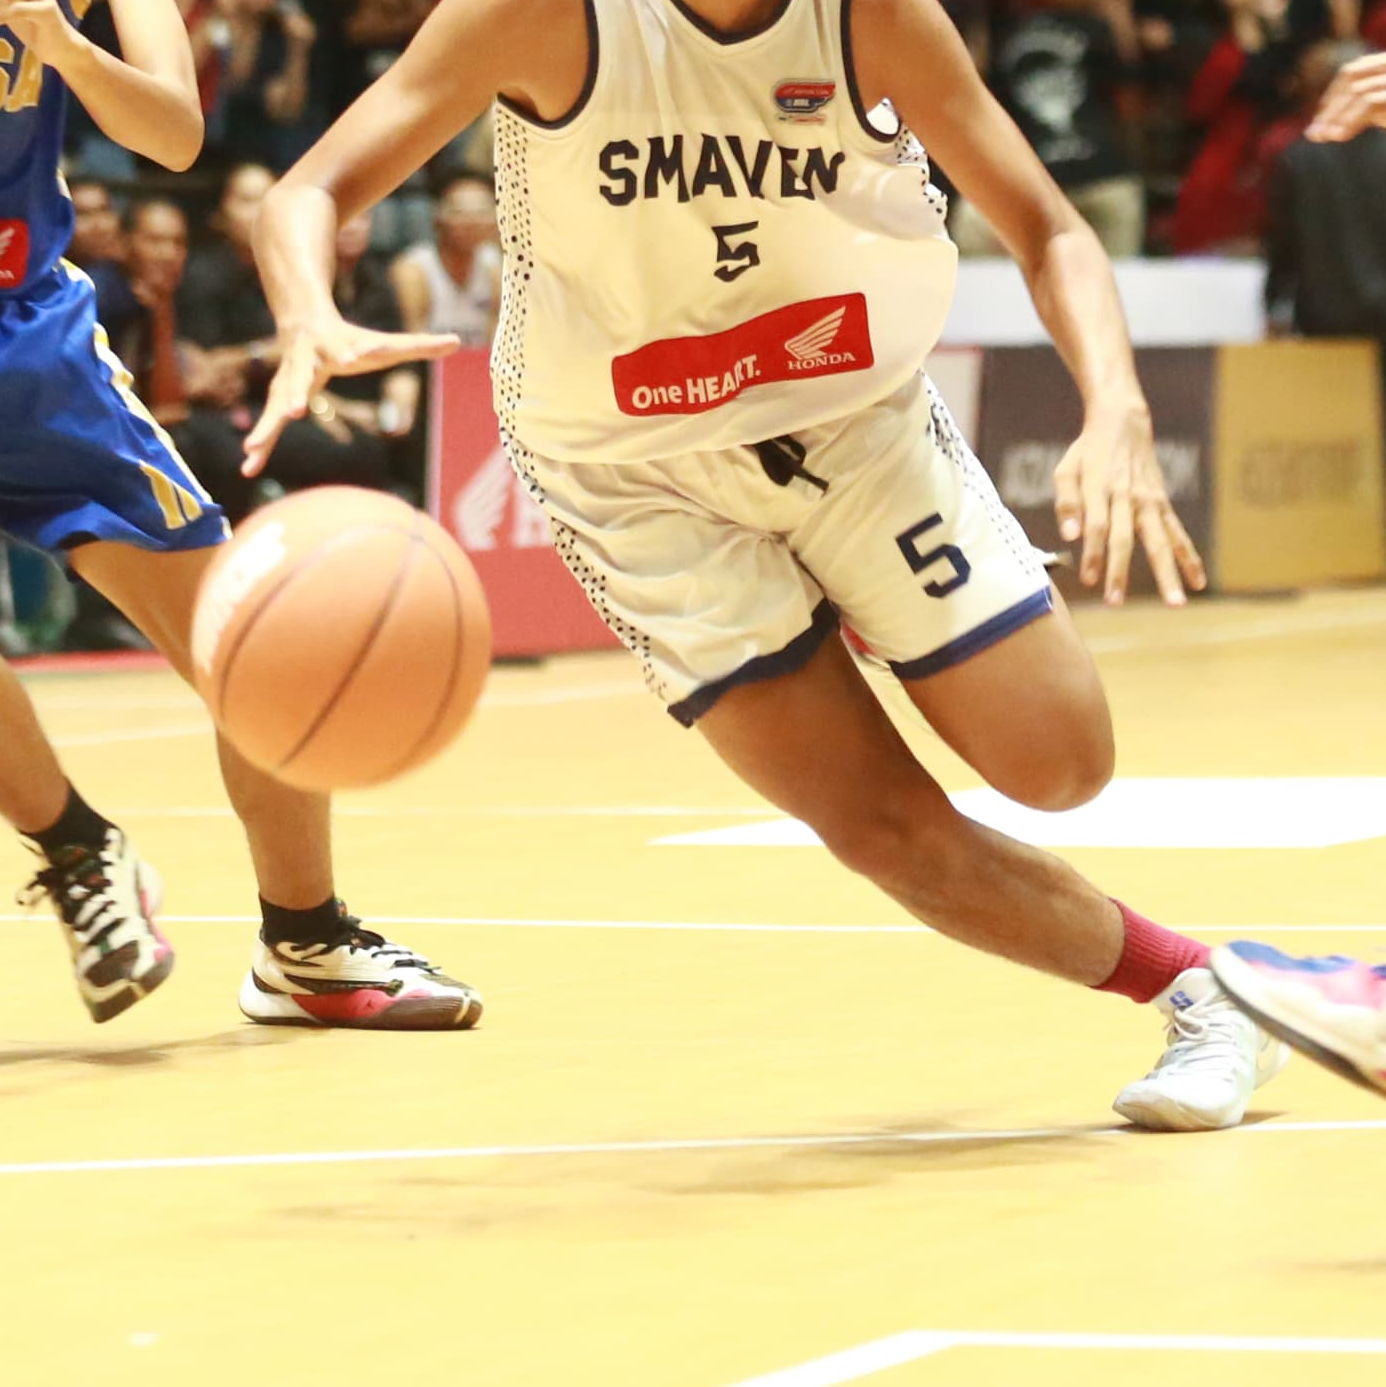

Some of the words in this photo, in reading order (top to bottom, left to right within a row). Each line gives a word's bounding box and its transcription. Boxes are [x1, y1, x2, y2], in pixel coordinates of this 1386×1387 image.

[599, 133, 846, 206] SMAVEN
[711, 220, 761, 283] 5
[631, 384, 683, 410] One
[686, 354, 762, 405] HEART.
[787, 351, 856, 371] HONDA
